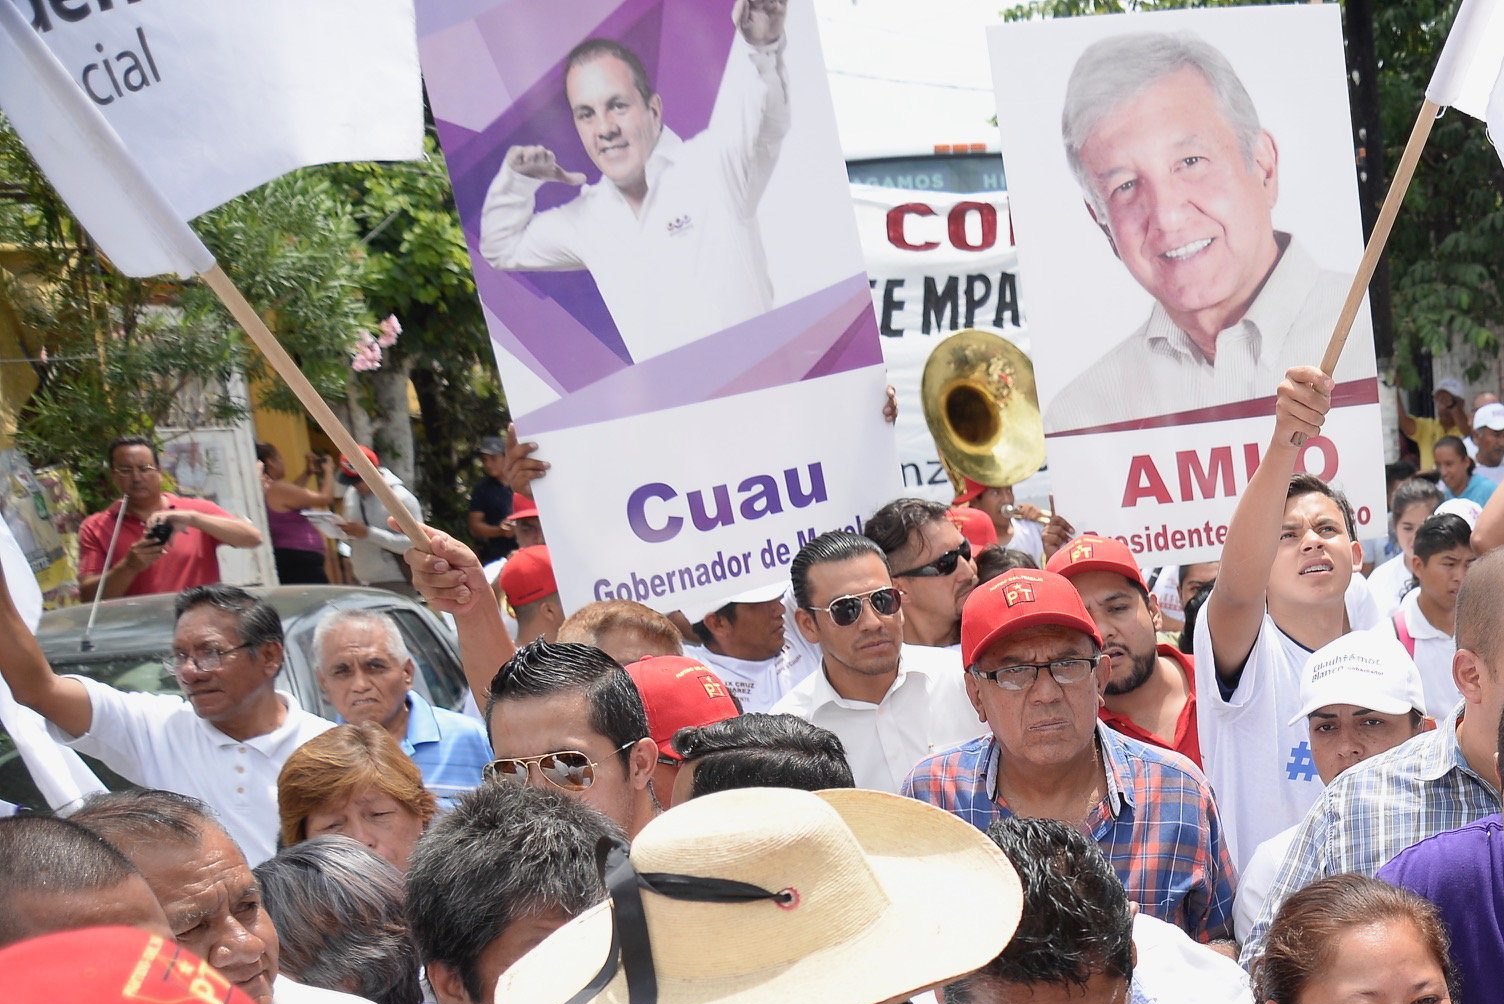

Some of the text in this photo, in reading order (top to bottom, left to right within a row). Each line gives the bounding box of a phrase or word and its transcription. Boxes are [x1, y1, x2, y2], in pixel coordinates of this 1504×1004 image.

[626, 461, 828, 544] Cuau
[760, 539, 791, 570] de
[1007, 588, 1032, 606] PT
[704, 682, 725, 698] PT
